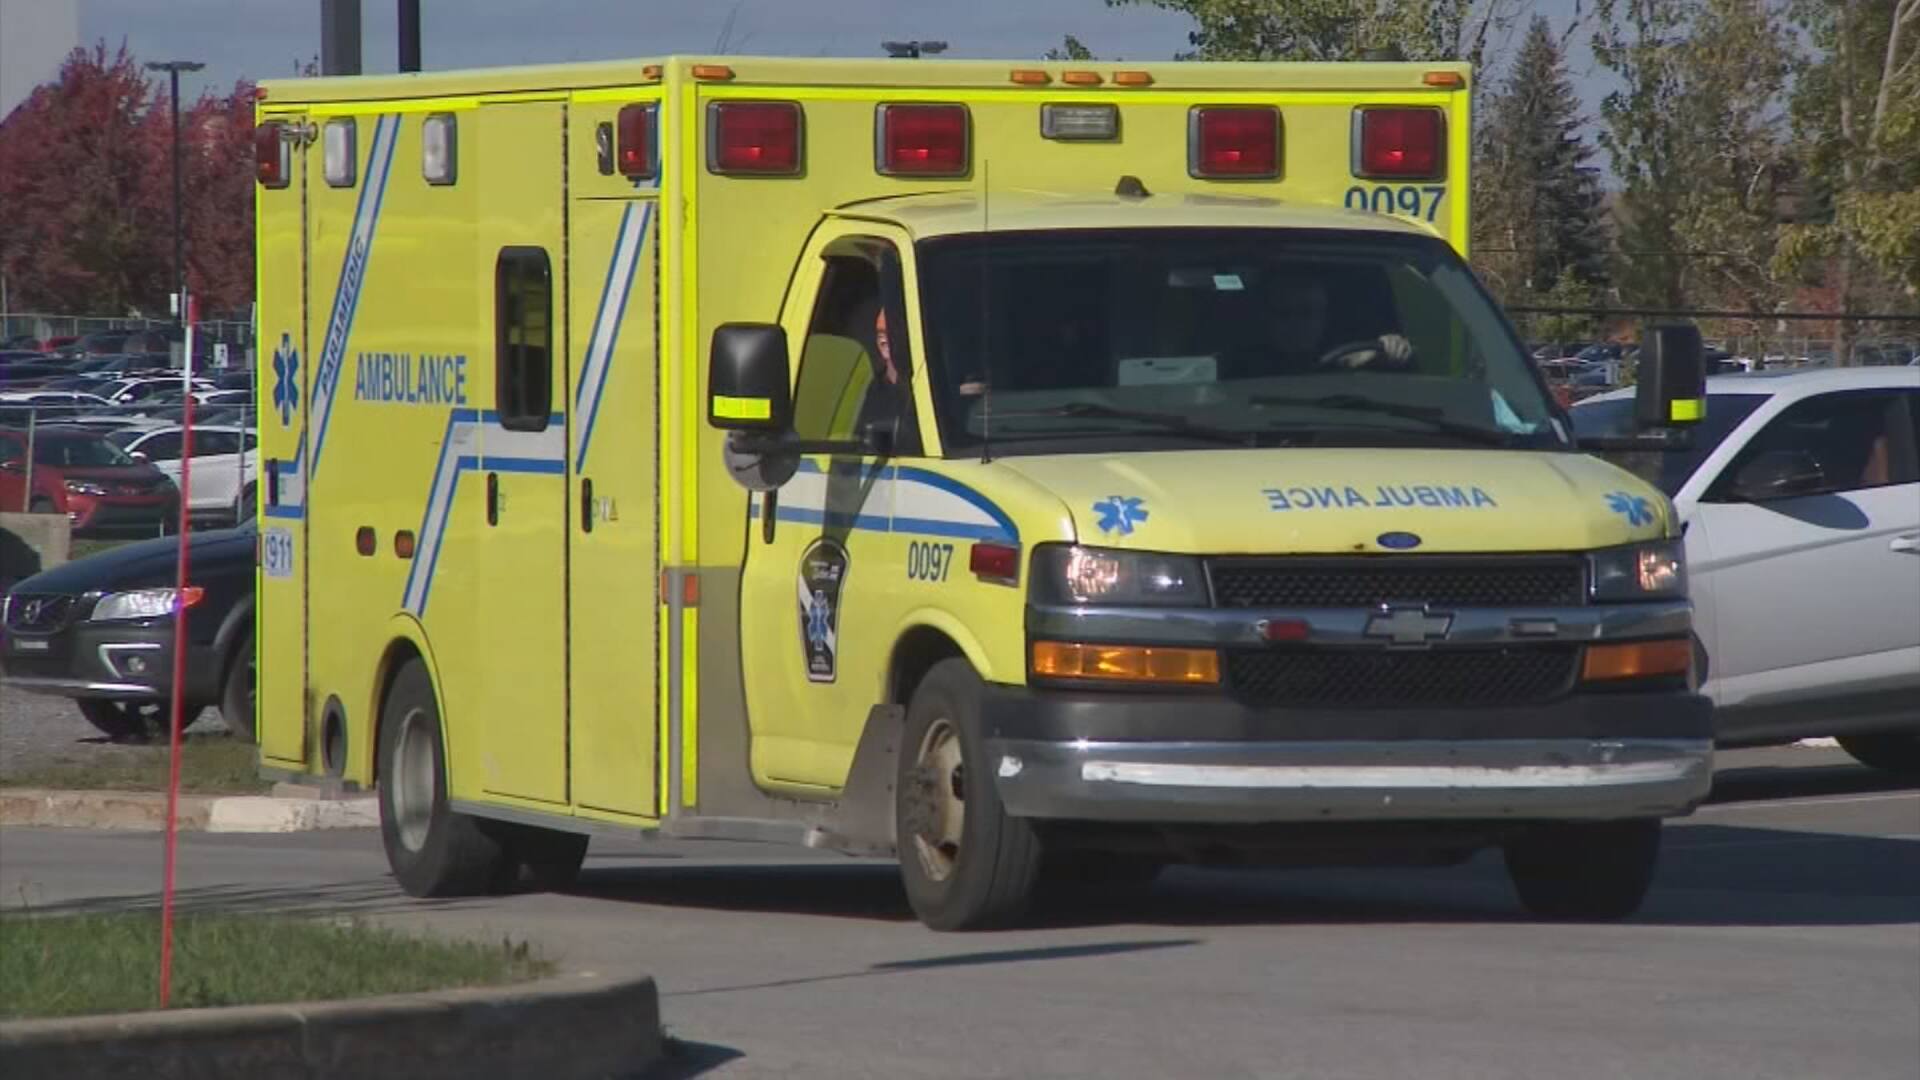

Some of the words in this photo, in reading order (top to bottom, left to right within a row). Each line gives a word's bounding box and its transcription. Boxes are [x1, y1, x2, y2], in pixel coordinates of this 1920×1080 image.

[1345, 185, 1446, 222] 0097
[321, 236, 365, 396] PARAMEDIC
[354, 352, 467, 404] AMBULANCE
[908, 540, 954, 582] 0097
